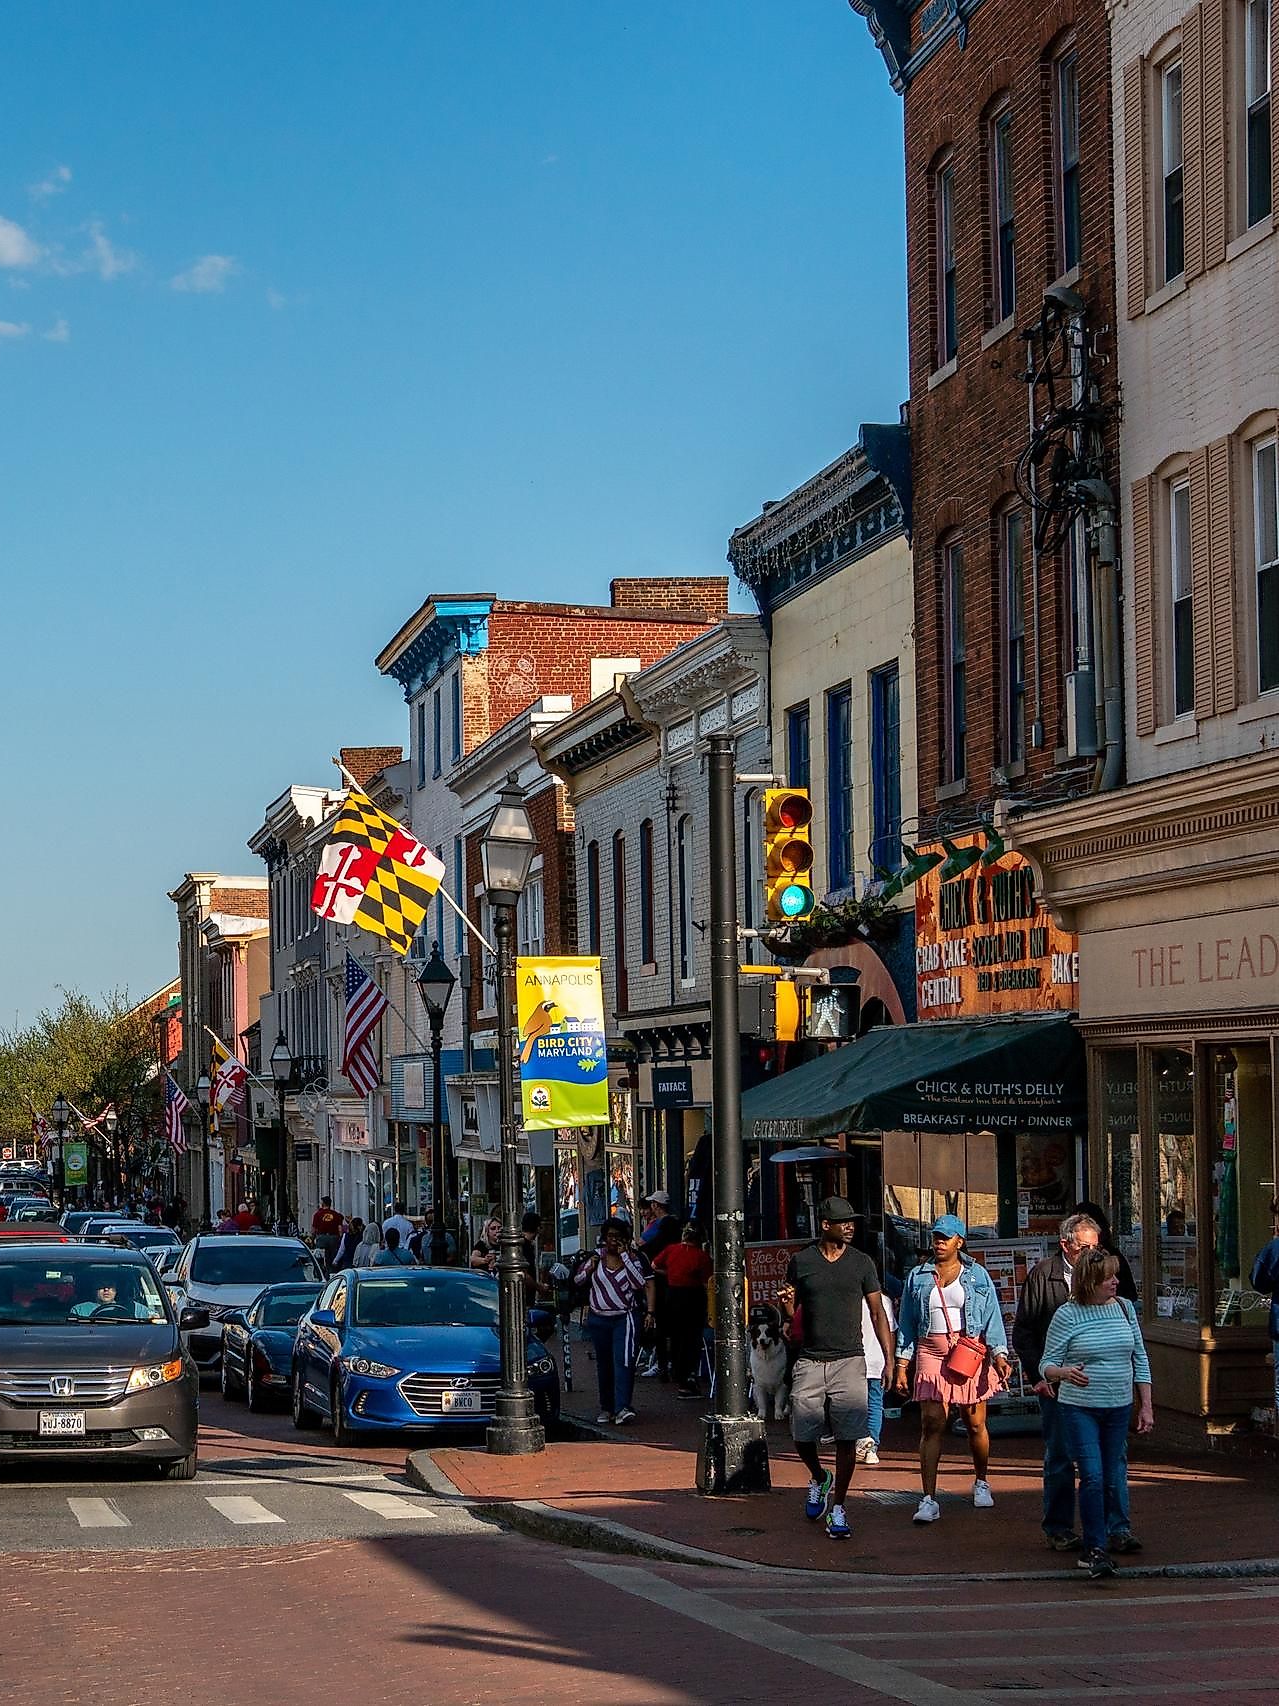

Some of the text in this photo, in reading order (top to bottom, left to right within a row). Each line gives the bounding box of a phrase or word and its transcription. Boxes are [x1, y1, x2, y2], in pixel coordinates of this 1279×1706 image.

[939, 879, 968, 930] CHICK
[916, 938, 967, 974] CRAB CAKE
[1132, 934, 1279, 988] THE LEAD
[1052, 952, 1079, 983] BAKE
[524, 974, 594, 986] ANNAPOLIS
[922, 975, 962, 1008] CENTRAL
[538, 1036, 592, 1048] BIRD CITY
[538, 1046, 593, 1058] MARYLAND
[658, 1081, 687, 1092] FATFACE
[915, 1080, 1064, 1095] CHICK & RUTH'S DELLY
[926, 1094, 941, 1102] The
[1018, 1097, 1056, 1107] Breakfast
[903, 1113, 1072, 1127] BREAKFAST LUNCH DINNER
